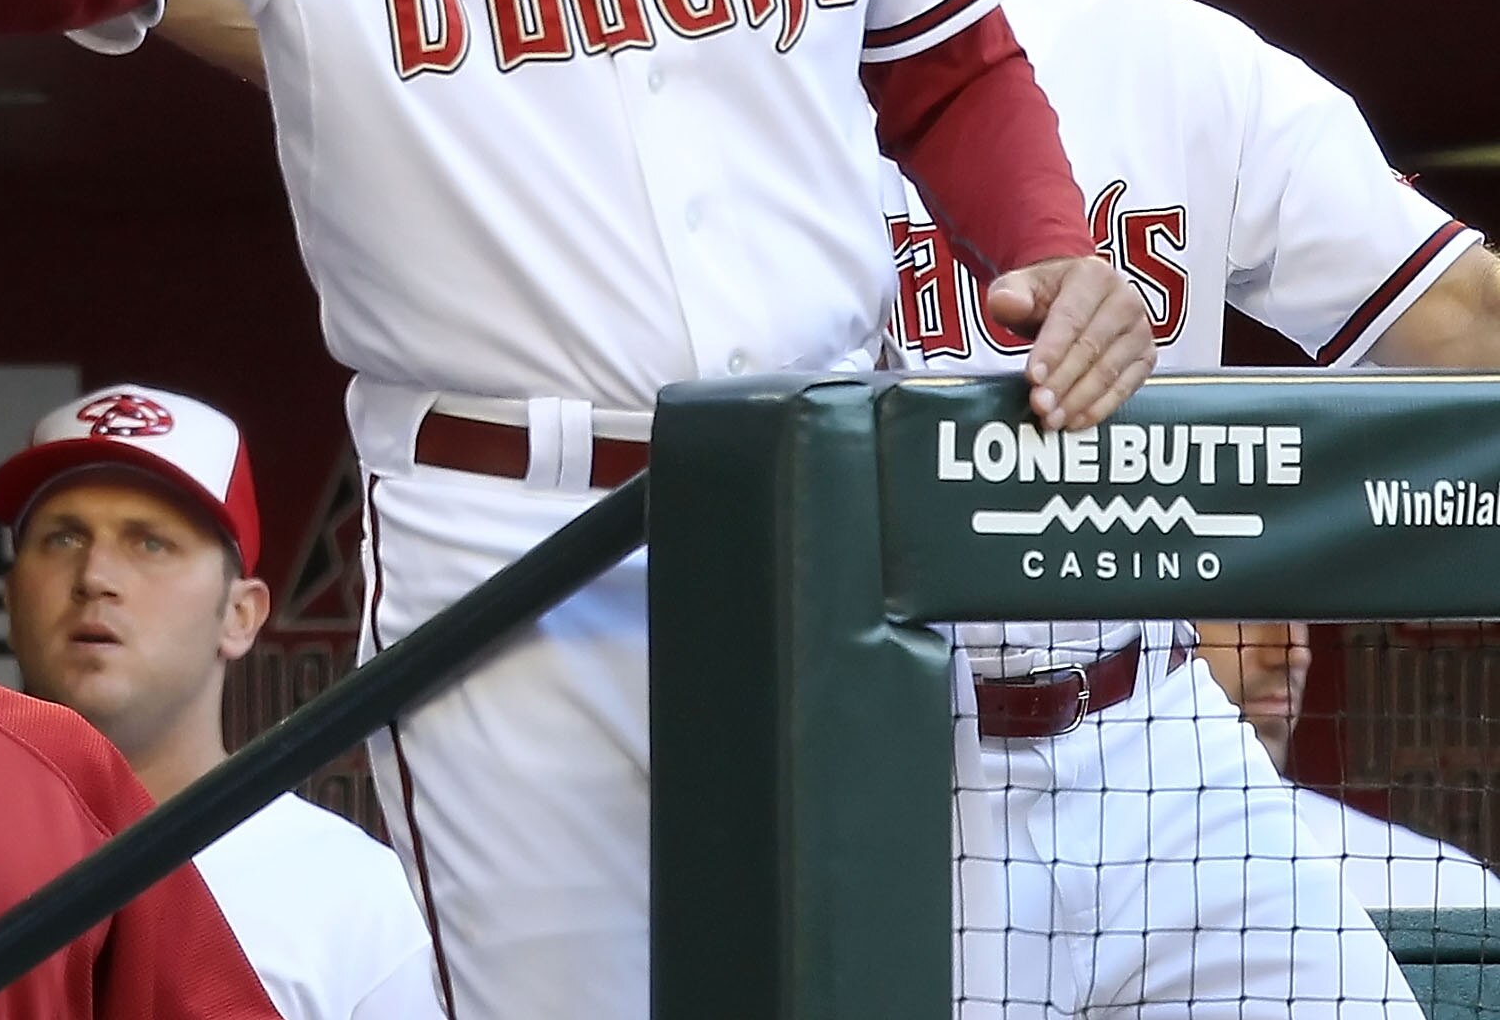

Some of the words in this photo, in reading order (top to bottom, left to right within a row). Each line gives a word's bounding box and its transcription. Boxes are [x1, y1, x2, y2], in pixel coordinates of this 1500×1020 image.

[937, 420, 1099, 482] LONE
[1108, 424, 1302, 485] BUTTE
[1364, 479, 1500, 526] WinGila
[1022, 550, 1221, 579] CASINO
